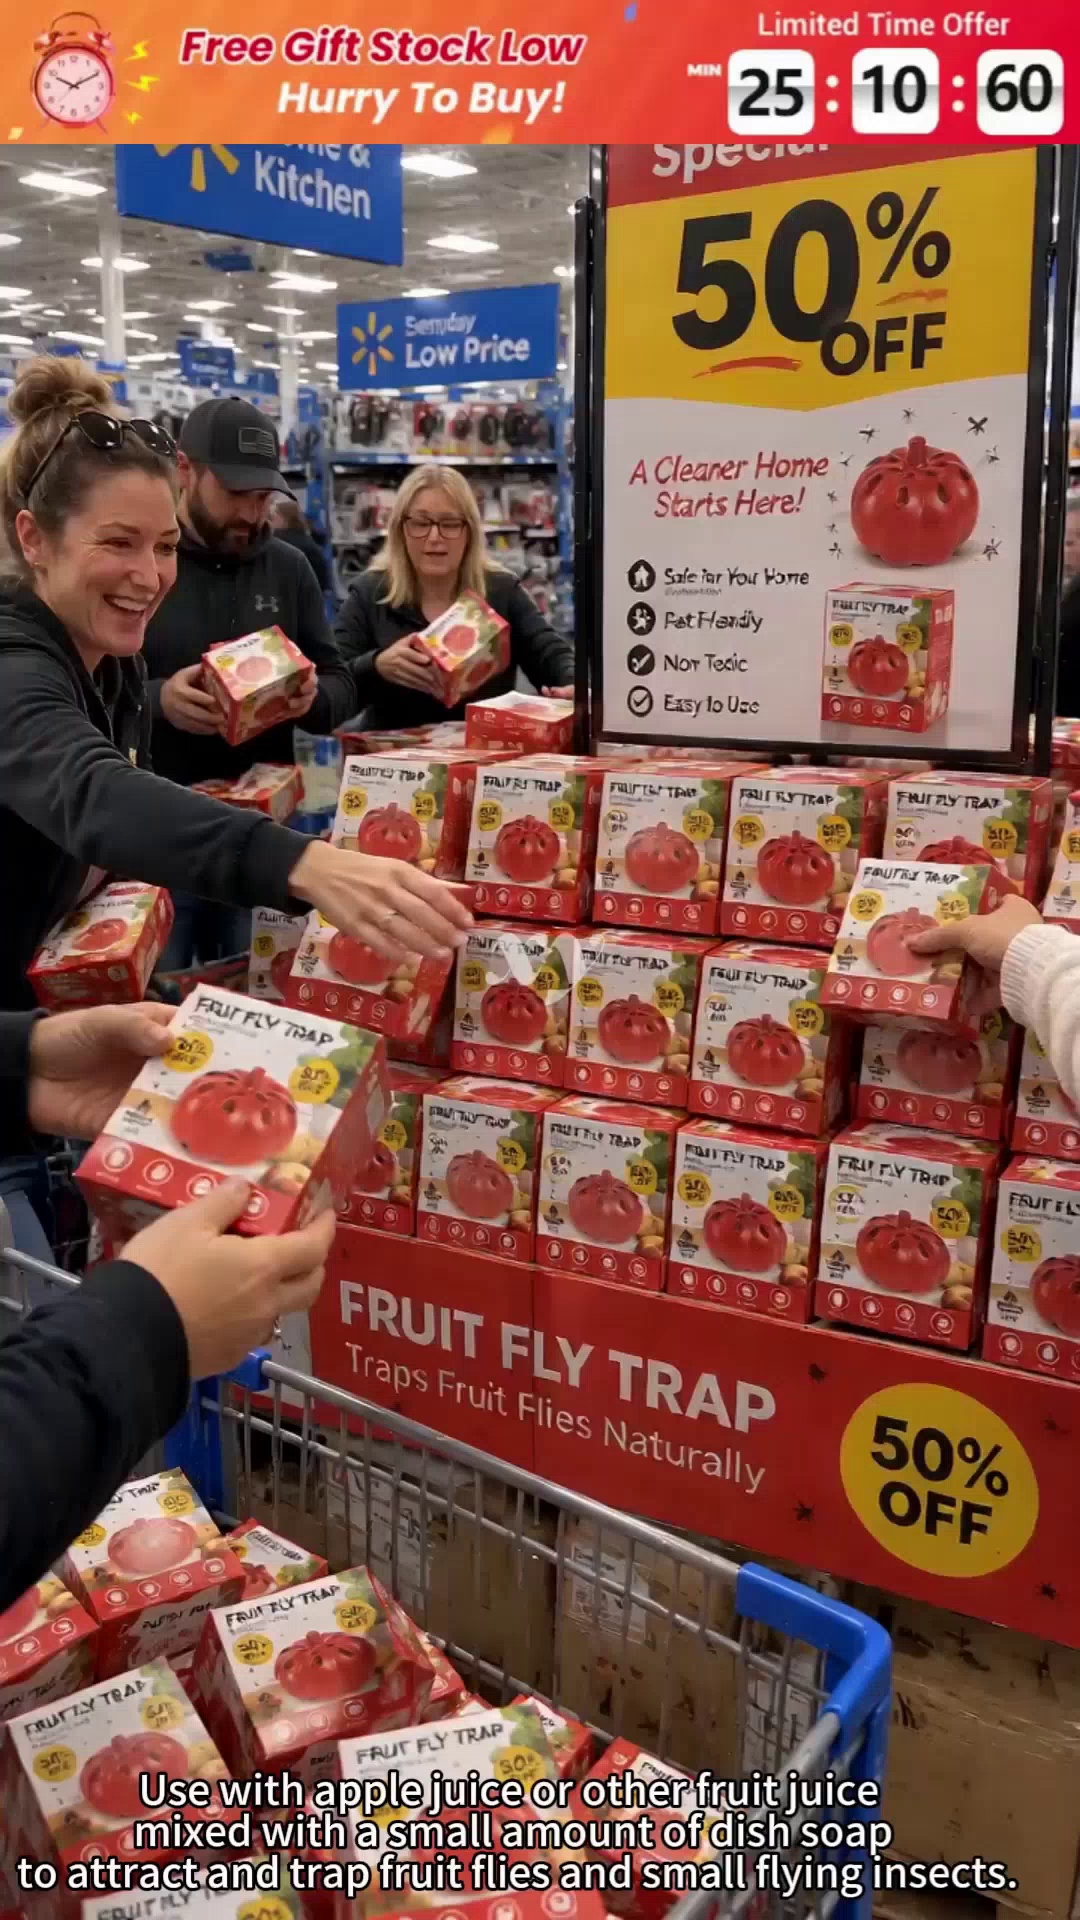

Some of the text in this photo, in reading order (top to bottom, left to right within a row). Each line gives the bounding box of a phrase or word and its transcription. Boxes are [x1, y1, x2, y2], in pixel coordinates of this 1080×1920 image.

[255, 150, 371, 220] Kitchen
[672, 187, 952, 350] 50%
[405, 334, 531, 368] Low Price
[820, 312, 947, 376] OFF
[629, 451, 829, 485] A Cleaner Home
[654, 486, 806, 518] Starts Here!
[339, 1279, 776, 1433] FRUIT FLY TRAP
[344, 1341, 766, 1495] Traps Fruit Flies Naturally
[870, 1415, 1009, 1497] 50%
[878, 1481, 993, 1545] OFF
[417, 1732, 448, 1751] FLY
[453, 1723, 504, 1745] TRAP
